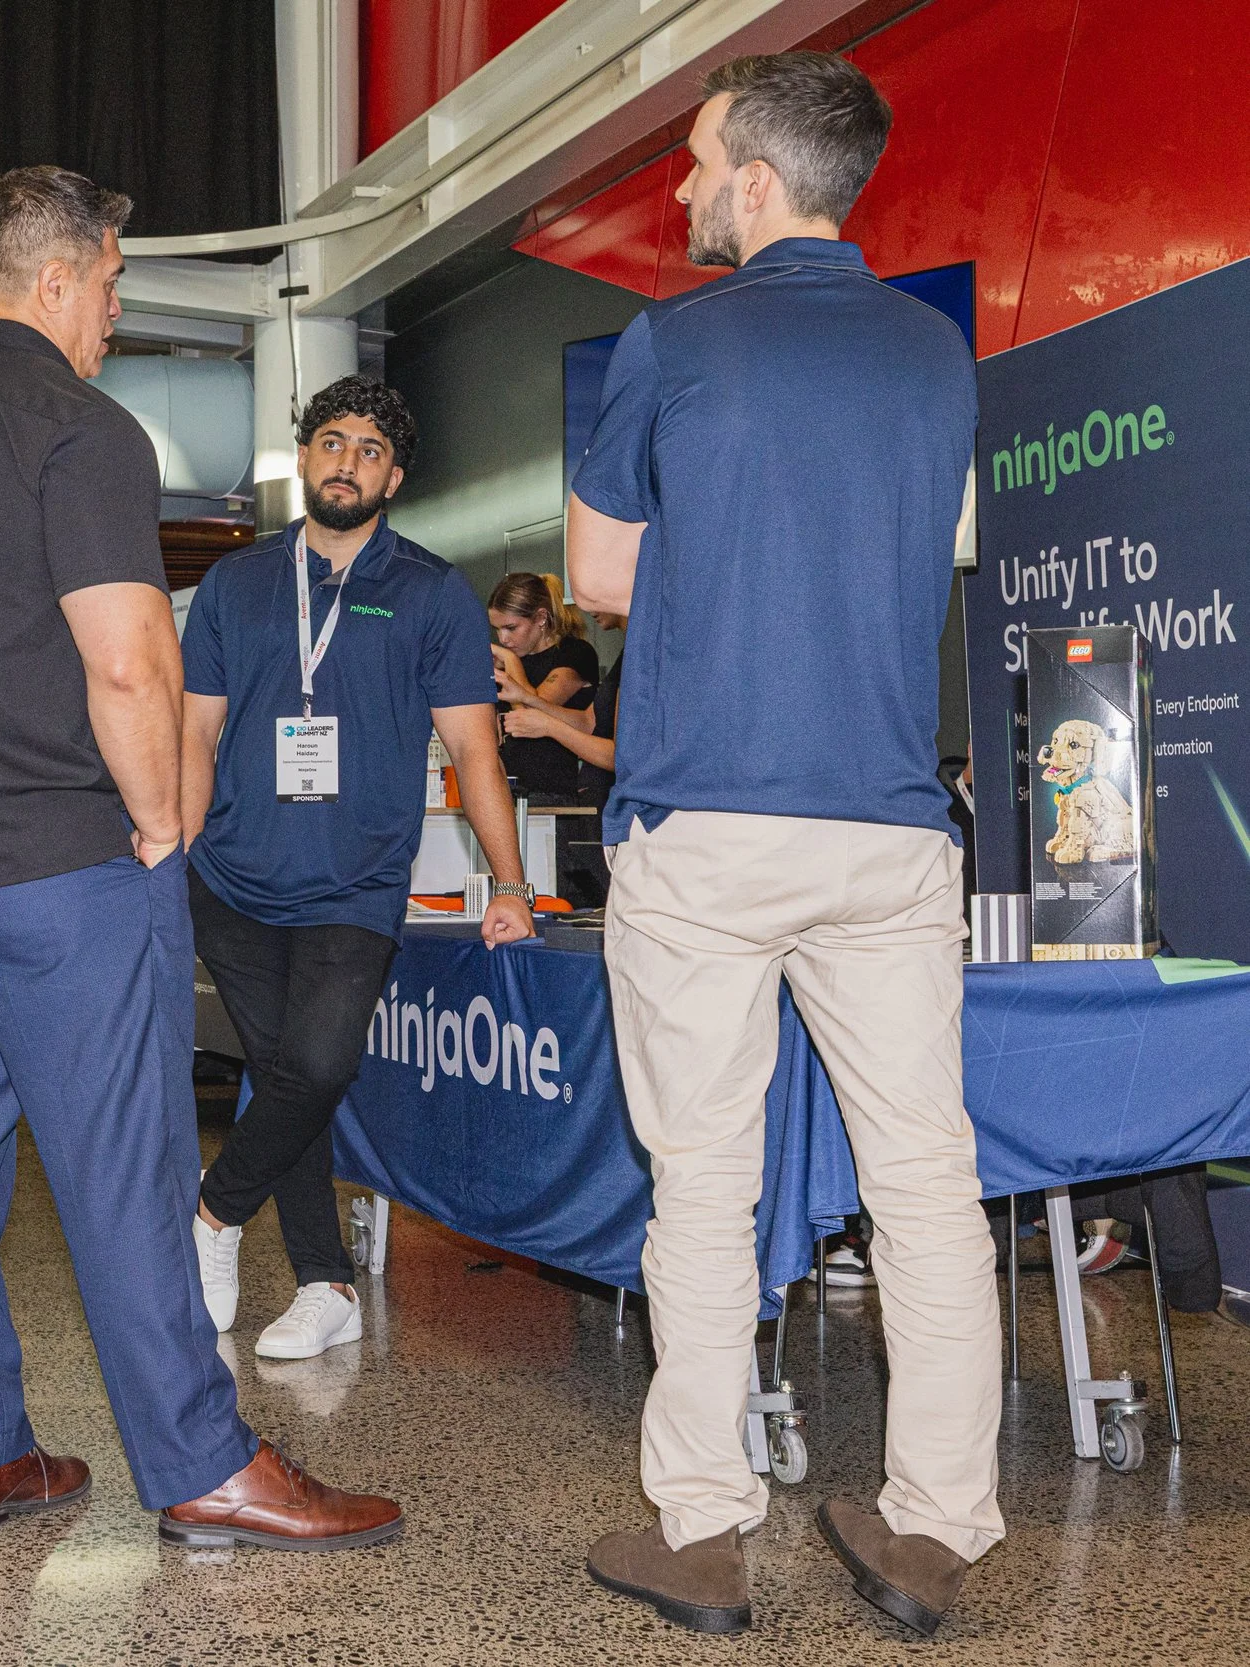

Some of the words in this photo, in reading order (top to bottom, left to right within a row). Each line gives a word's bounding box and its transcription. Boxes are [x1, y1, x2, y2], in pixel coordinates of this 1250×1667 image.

[1000, 546, 1078, 609] Unify
[1086, 536, 1112, 590] IT
[1120, 537, 1157, 583] to
[350, 605, 394, 618] ninjaOne
[1135, 589, 1237, 652] Work
[1069, 646, 1091, 656] LEGO
[1156, 699, 1185, 717] Every
[1187, 693, 1240, 714] Endpoint
[1154, 738, 1213, 756] utomation
